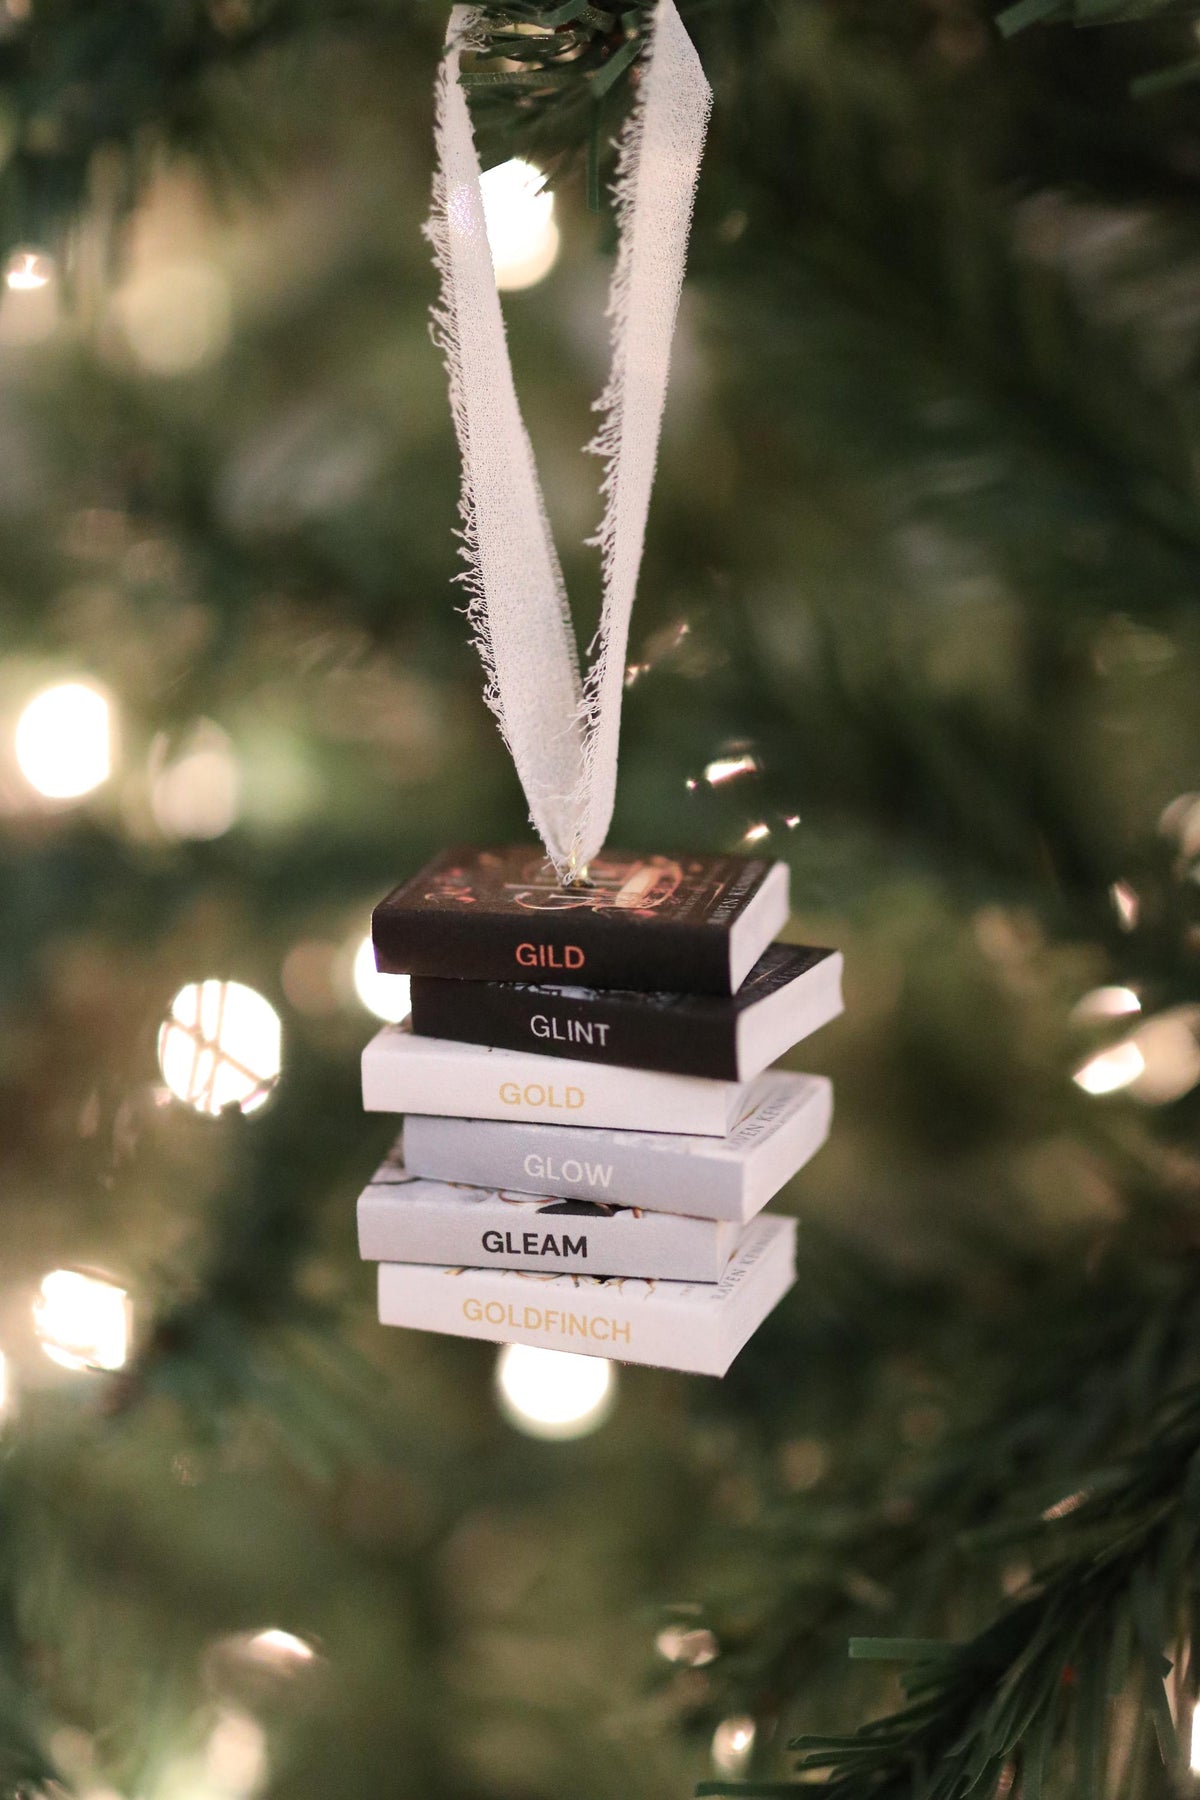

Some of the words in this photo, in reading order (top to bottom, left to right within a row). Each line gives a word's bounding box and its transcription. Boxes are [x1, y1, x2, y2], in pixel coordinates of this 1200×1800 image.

[515, 942, 585, 969] GILD
[530, 1015, 610, 1047] GLINT
[499, 1082, 585, 1109] GOLD
[524, 1154, 613, 1187] GLOW
[482, 1231, 587, 1258] GLEAM
[462, 1298, 631, 1343] GOLDFINCH
